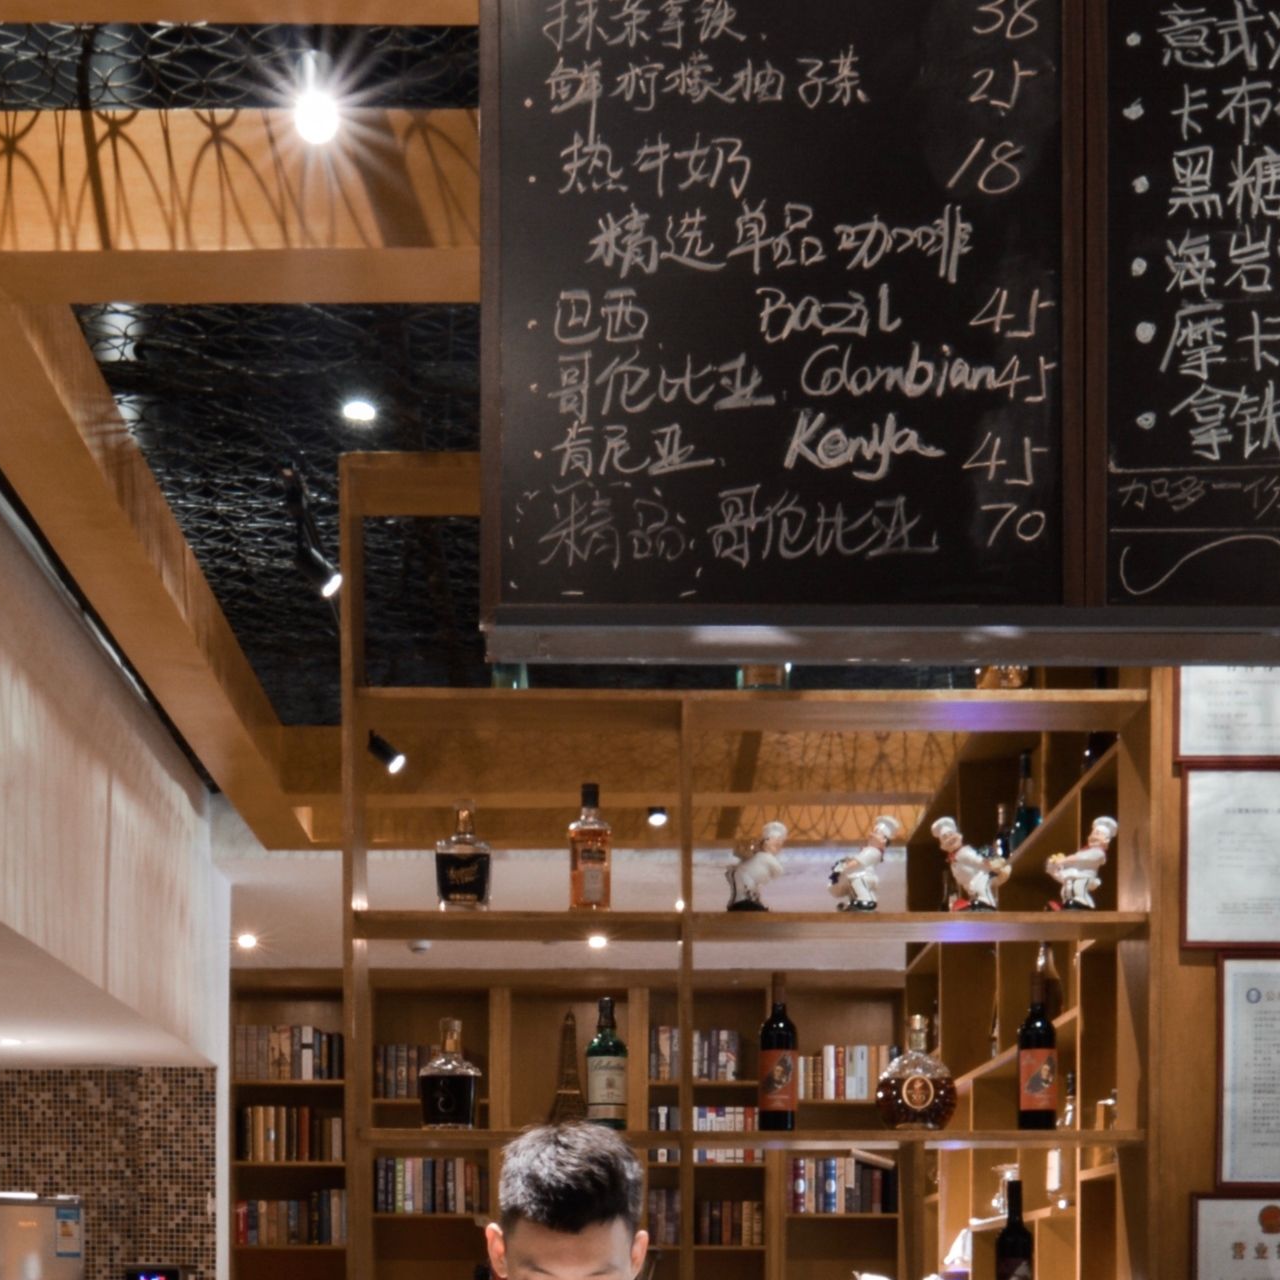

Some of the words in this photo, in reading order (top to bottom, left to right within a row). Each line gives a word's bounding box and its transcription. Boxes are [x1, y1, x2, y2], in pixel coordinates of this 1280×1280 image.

[972, 0, 1039, 39] 38
[543, 45, 869, 125] 鲜柠檬柚子茶
[969, 60, 1036, 110] 25
[559, 131, 751, 198] 热牛奶
[947, 138, 1024, 194] 18
[586, 202, 974, 283] 精选单品咖啡
[554, 289, 649, 343] 巴西
[970, 288, 1055, 338] 45
[547, 350, 776, 421] 哥伦比亚
[801, 342, 999, 398] Colombian
[994, 354, 1056, 402] 45
[552, 422, 716, 478] 肯尼亚
[784, 411, 947, 481] Kenya
[962, 432, 1048, 484] 45
[981, 505, 1045, 547] 70
